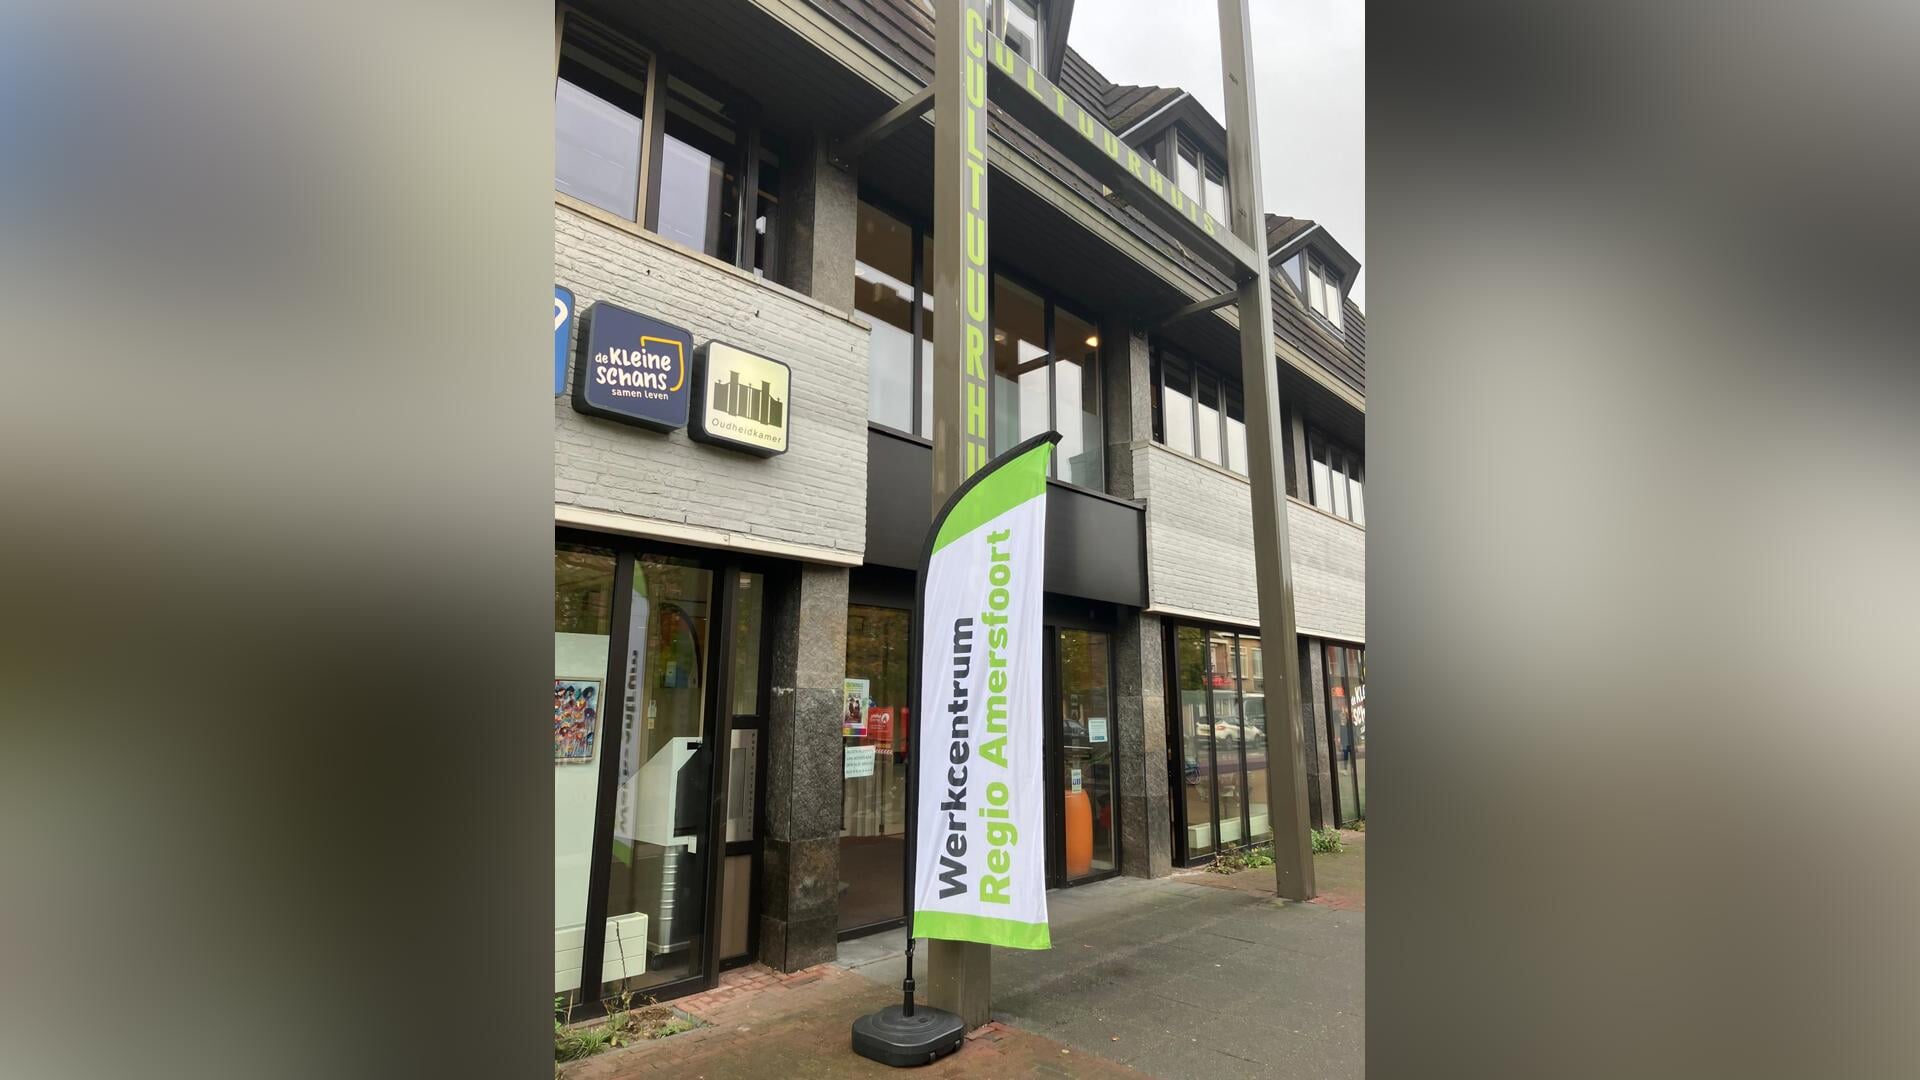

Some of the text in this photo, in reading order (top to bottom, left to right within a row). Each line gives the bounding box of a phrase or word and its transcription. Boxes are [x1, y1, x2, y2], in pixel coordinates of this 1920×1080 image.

[995, 41, 1215, 237] ULTUURHUIS
[966, 8, 985, 478] CULTUURHU
[595, 352, 609, 364] de
[611, 387, 669, 401] samen leven
[711, 417, 783, 444] Oudheidkamer
[938, 616, 974, 900] Werkcentrum
[979, 528, 1018, 905] Regio Amersfoort
